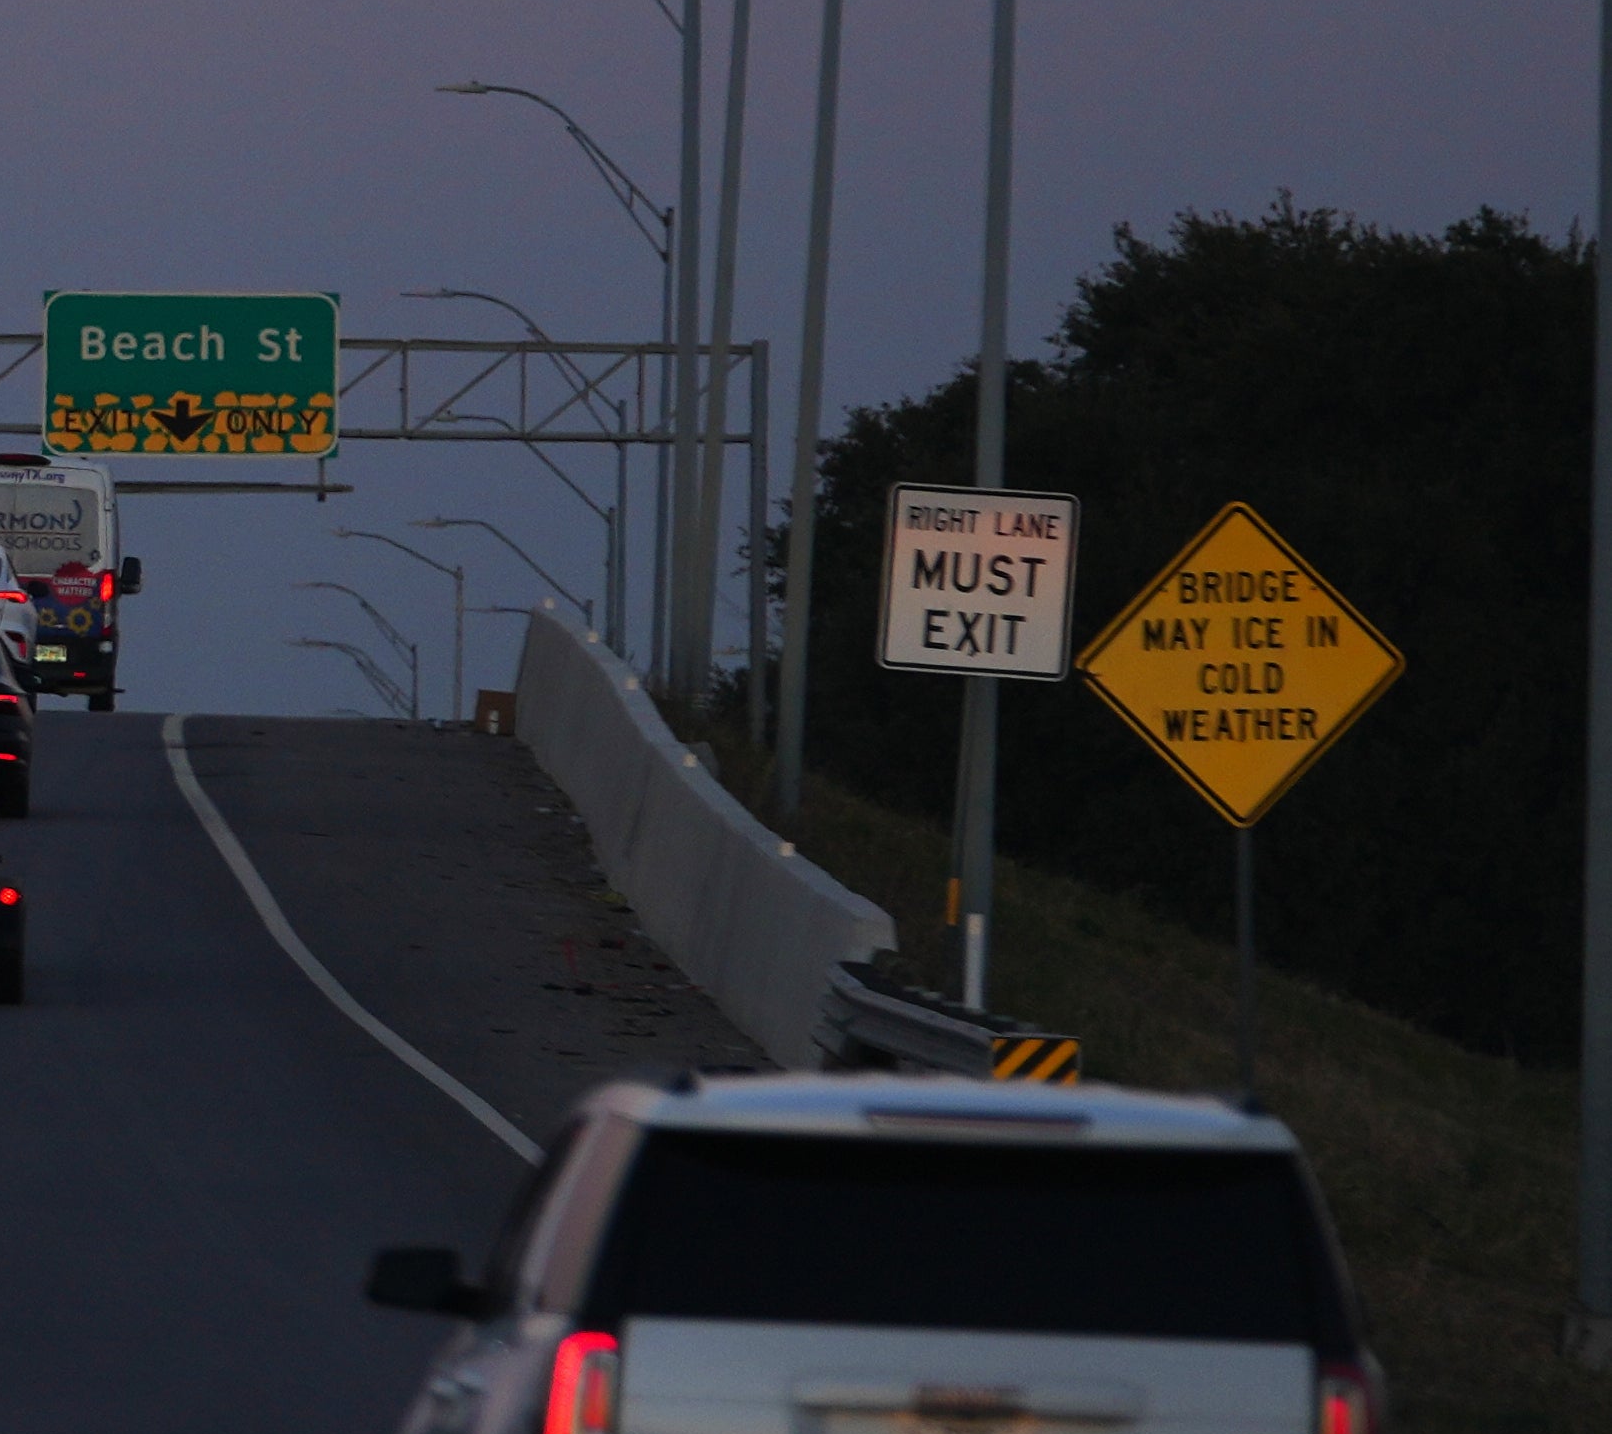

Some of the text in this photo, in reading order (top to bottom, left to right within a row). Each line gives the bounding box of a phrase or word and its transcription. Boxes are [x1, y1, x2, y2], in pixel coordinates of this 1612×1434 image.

[80, 325, 303, 363] Beach St
[64, 409, 320, 435] EXIT ONLY
[906, 505, 1060, 540] RIGHT LANE
[912, 549, 1047, 598] MUST
[1177, 569, 1300, 604] BRIDGE
[922, 609, 1027, 656] EXIT
[1143, 615, 1339, 651] MAY ICE IN
[1199, 662, 1285, 695] COLD
[1164, 707, 1319, 741] WEATHER
